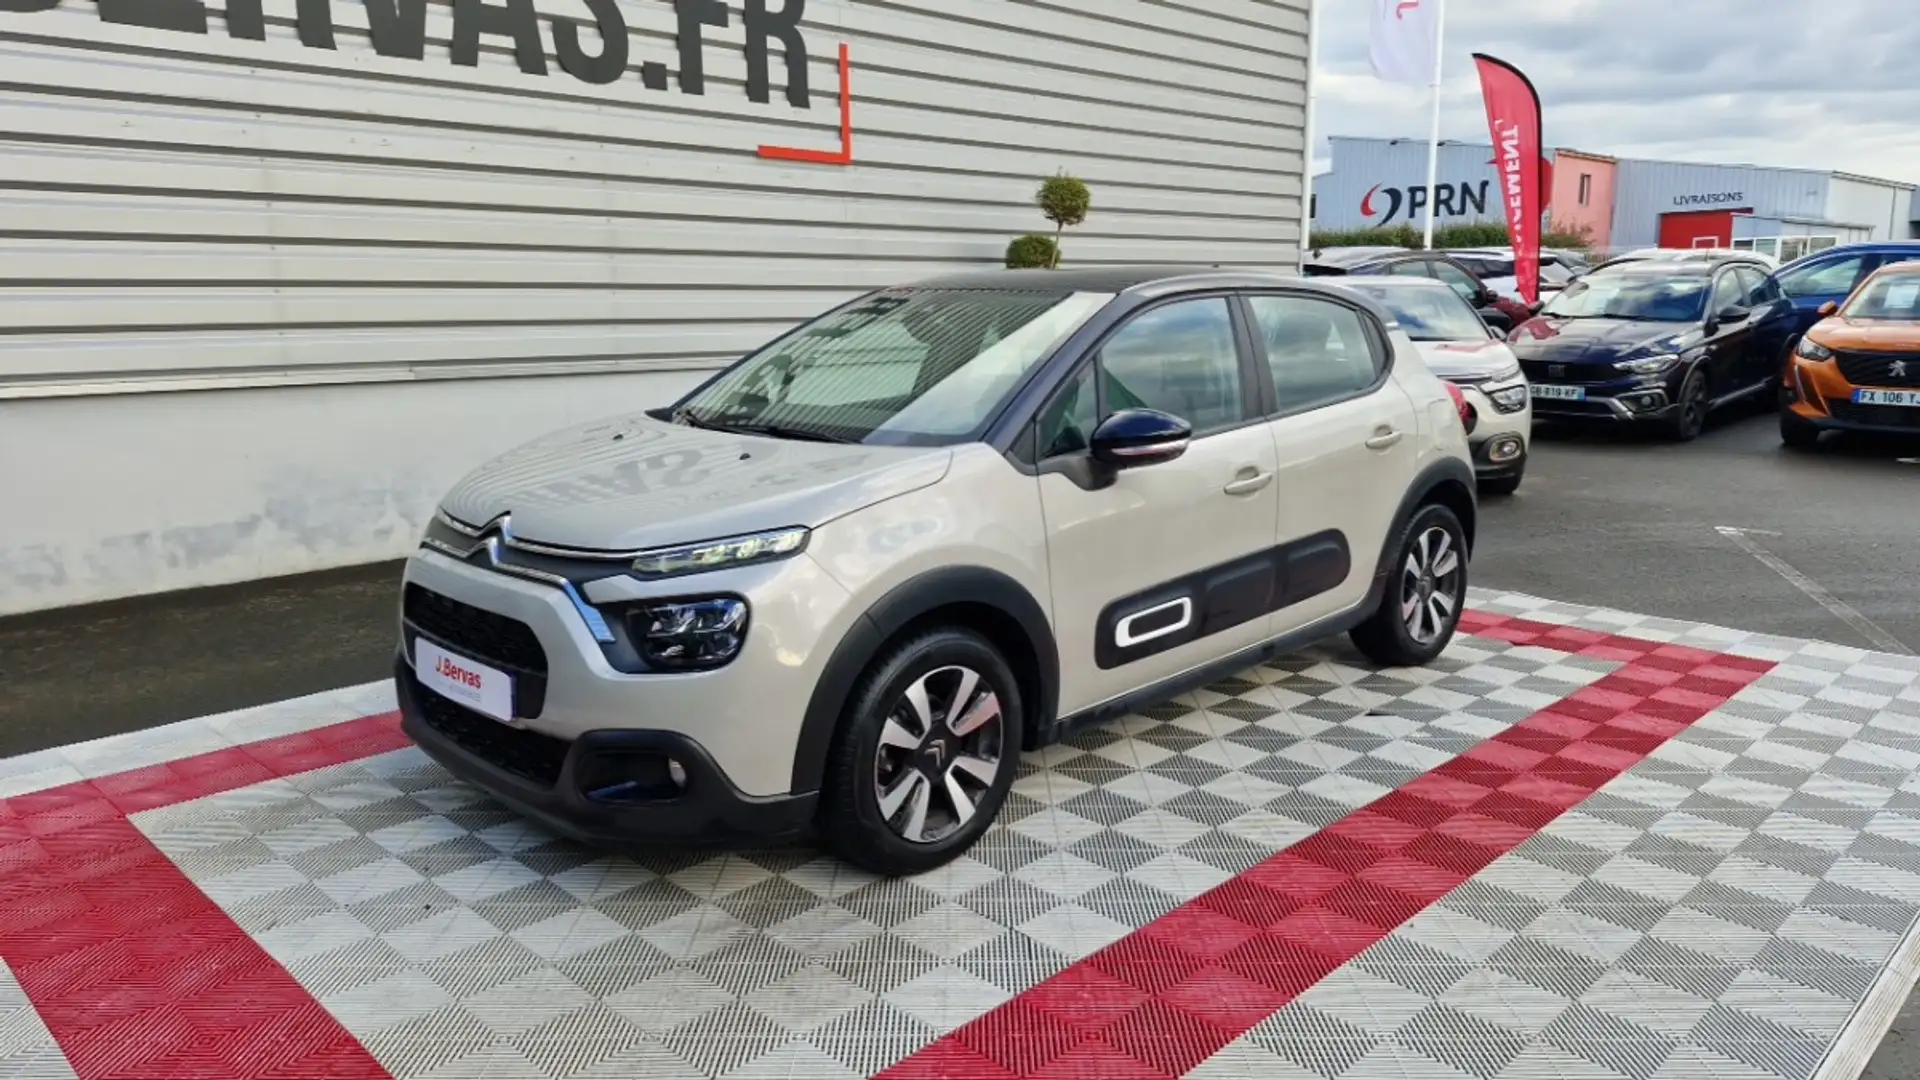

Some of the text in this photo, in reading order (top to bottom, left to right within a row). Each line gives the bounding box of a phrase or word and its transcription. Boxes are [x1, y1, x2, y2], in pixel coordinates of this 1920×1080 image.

[1408, 180, 1490, 219] PRN
[1674, 192, 1744, 206] LIVRAISONS
[1883, 391, 1904, 403] 106
[435, 656, 482, 689] J.Bervas
